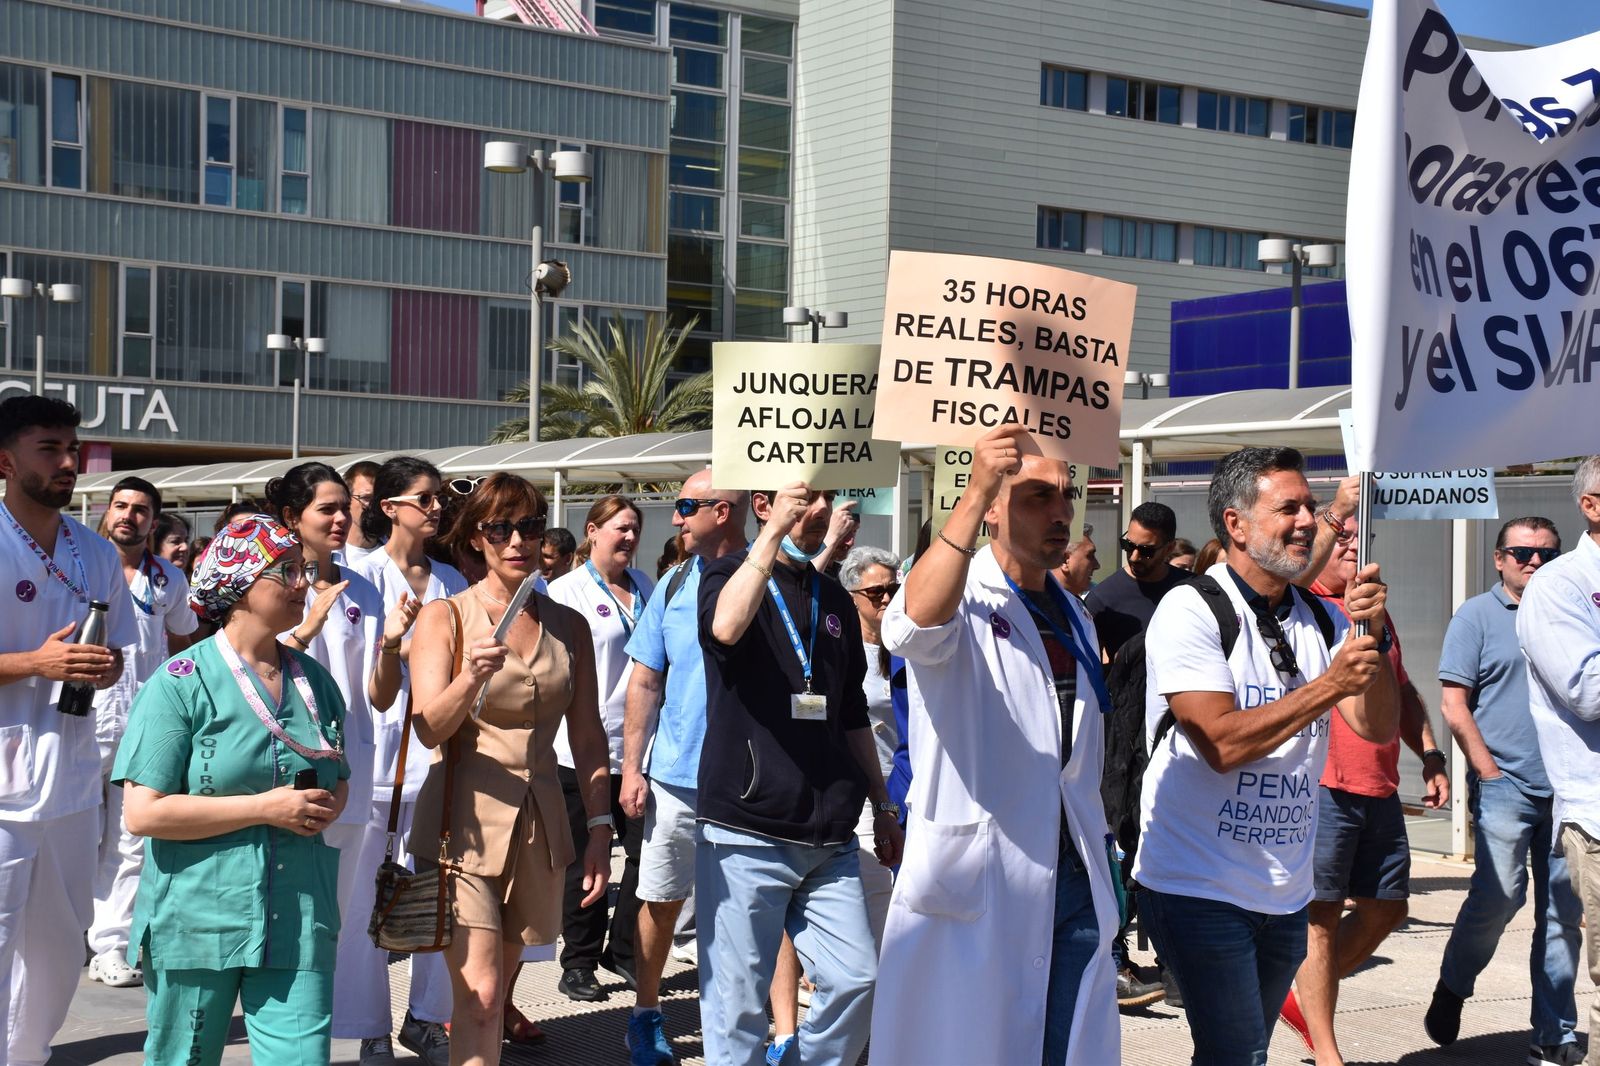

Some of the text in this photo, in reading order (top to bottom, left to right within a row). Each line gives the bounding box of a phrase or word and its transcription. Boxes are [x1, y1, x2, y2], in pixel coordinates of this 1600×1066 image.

[1405, 132, 1530, 216] oras
[1446, 225, 1492, 302] el
[943, 278, 1087, 321] 35 HORAS
[894, 313, 1119, 367] REALES, BASTA
[1394, 325, 1425, 411] y
[1426, 313, 1478, 394] el
[0, 380, 179, 433] UTA
[893, 357, 1111, 411] DE TRAMPAS
[738, 407, 847, 430] AFLOJA
[932, 399, 1072, 440] FISCALES
[747, 440, 873, 464] CARTERA
[1373, 486, 1489, 505] IUDADANOS
[1236, 771, 1312, 800] PENA
